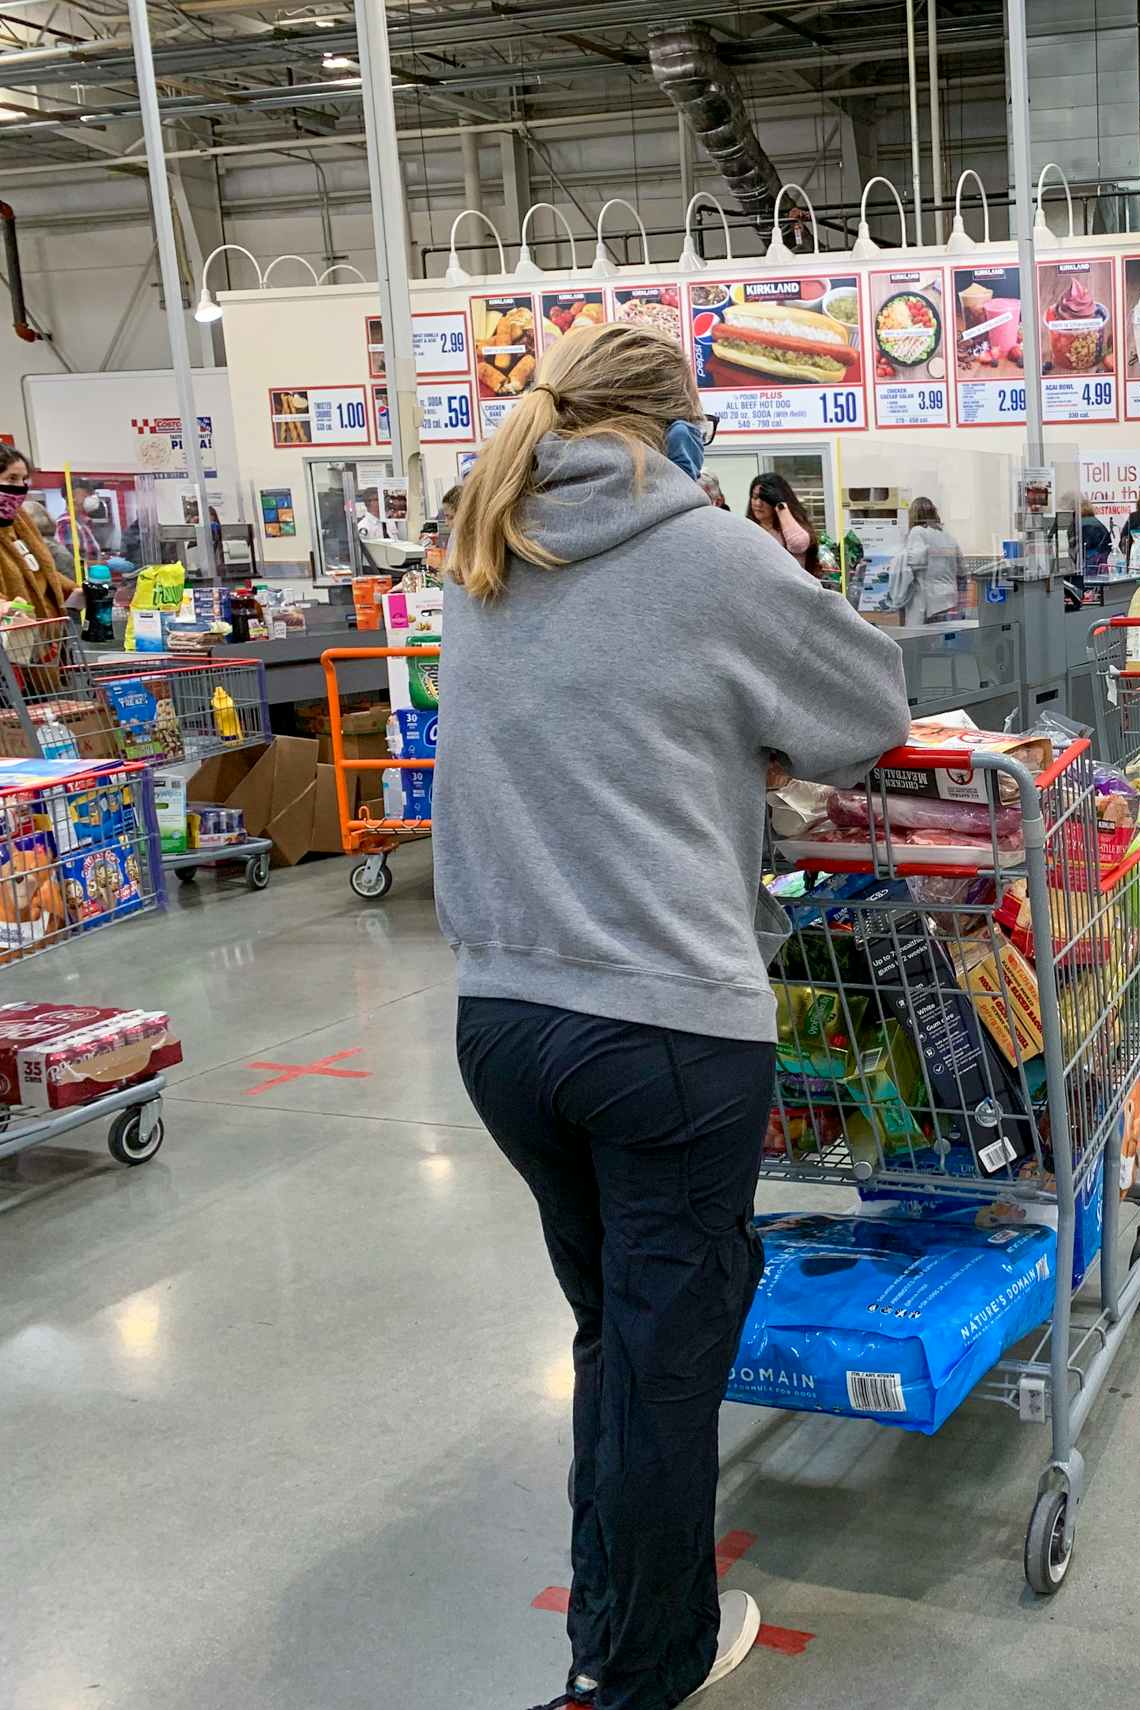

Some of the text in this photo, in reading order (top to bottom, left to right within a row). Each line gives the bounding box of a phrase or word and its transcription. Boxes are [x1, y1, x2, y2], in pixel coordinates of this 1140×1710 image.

[745, 282, 800, 295] KIRKLAND
[440, 332, 464, 353] 2.99
[759, 391, 783, 400] PLUS
[918, 390, 943, 410] 3.99
[998, 389, 1027, 411] 2.99
[1082, 382, 1112, 406] 4.99
[443, 394, 470, 428] .59
[726, 399, 791, 410] ALL BEEF HOT DOG
[819, 391, 857, 424] 1.50
[336, 401, 365, 429] 1.00
[752, 409, 771, 418] SODA
[158, 420, 183, 428] COSTC
[171, 439, 212, 450] PIA!
[1082, 462, 1110, 483] Tell
[1117, 465, 1137, 482] us
[406, 713, 418, 722] 30
[885, 778, 919, 790] CHICKEN
[872, 956, 884, 968] Up
[883, 953, 892, 963] to
[877, 962, 896, 977] gums
[902, 954, 909, 963] 2
[916, 1002, 936, 1016] White
[925, 1019, 942, 1032] Gum
[24, 1061, 43, 1076] 35
[960, 1294, 1007, 1341] NATURE'S
[1006, 1268, 1036, 1299] DOMAIN
